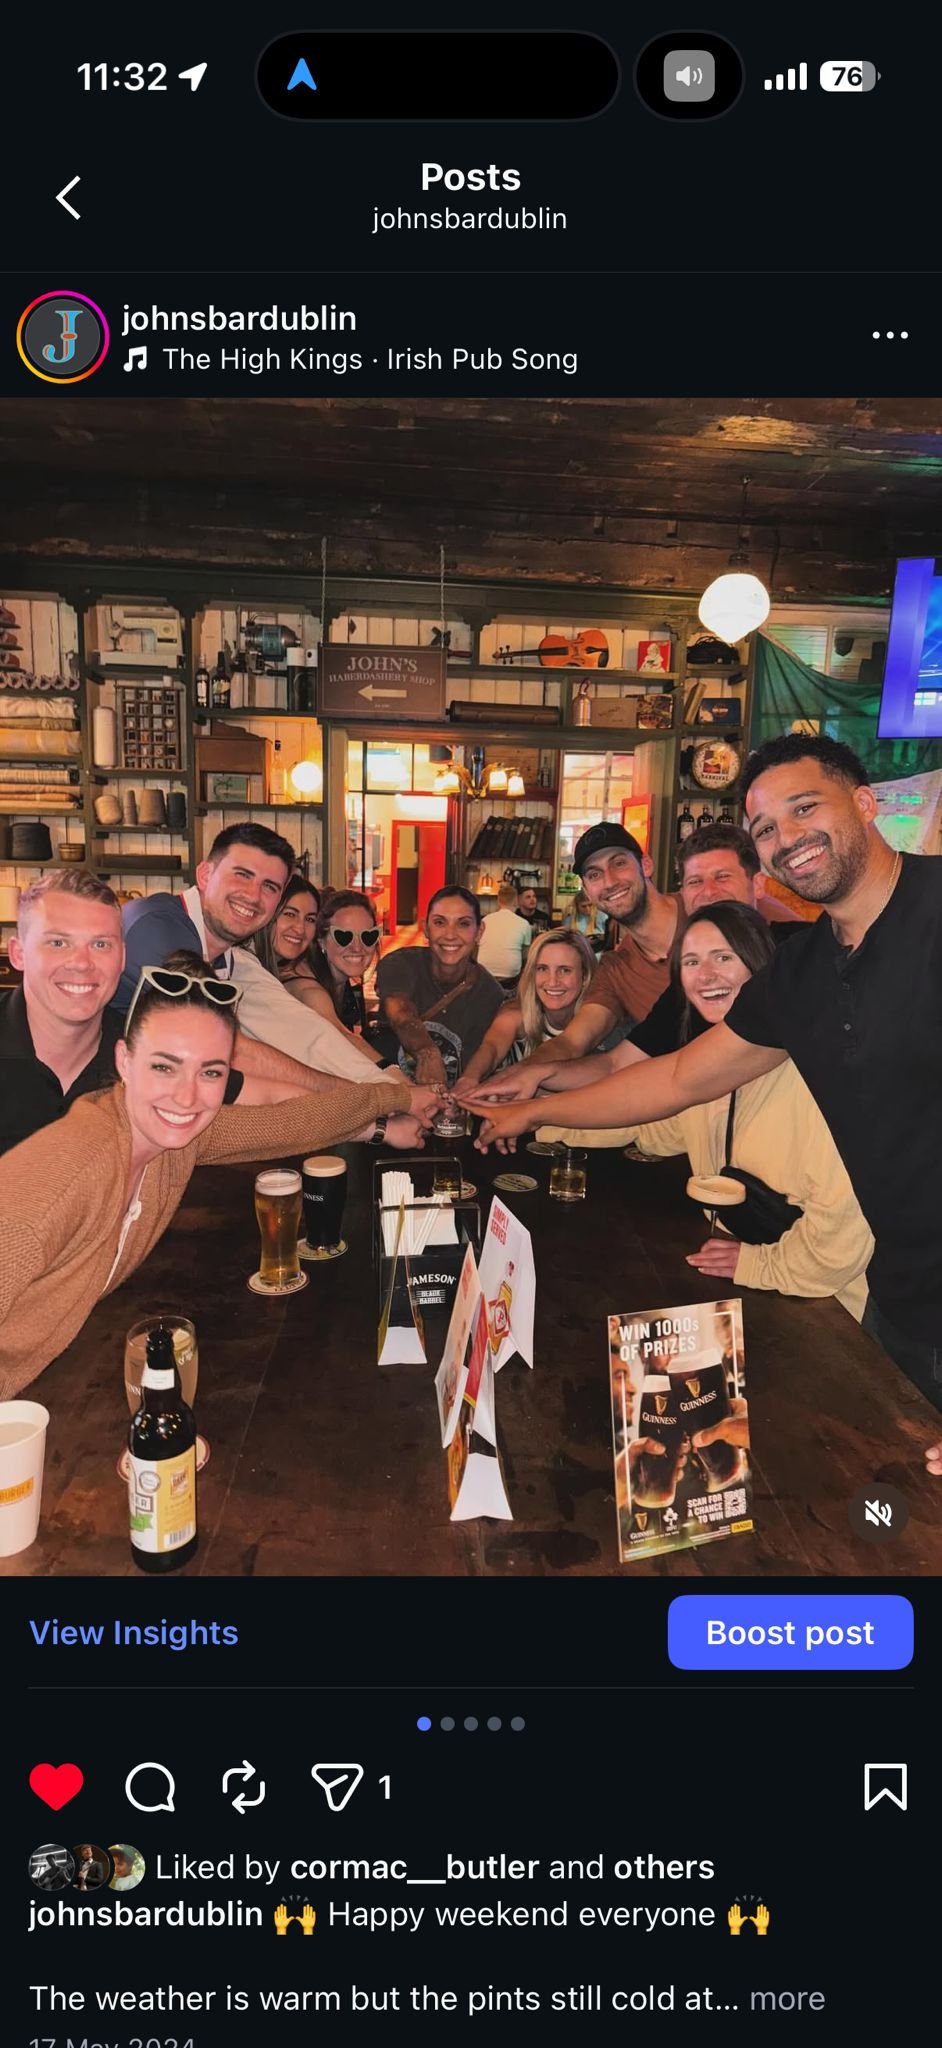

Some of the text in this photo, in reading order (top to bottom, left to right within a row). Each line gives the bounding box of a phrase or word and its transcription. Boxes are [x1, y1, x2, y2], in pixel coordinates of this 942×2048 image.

[347, 656, 418, 673] JOHN'S
[410, 676, 435, 686] SHOP
[619, 1317, 699, 1342] WIN 1000s
[619, 1335, 696, 1362] OF PRIZES
[679, 1390, 718, 1412] GUINNESS
[641, 1412, 678, 1425] GUINNESS
[687, 1493, 723, 1508] SCAN FOR
[687, 1502, 723, 1518] A CHANCE
[698, 1511, 724, 1524] TO WIN
